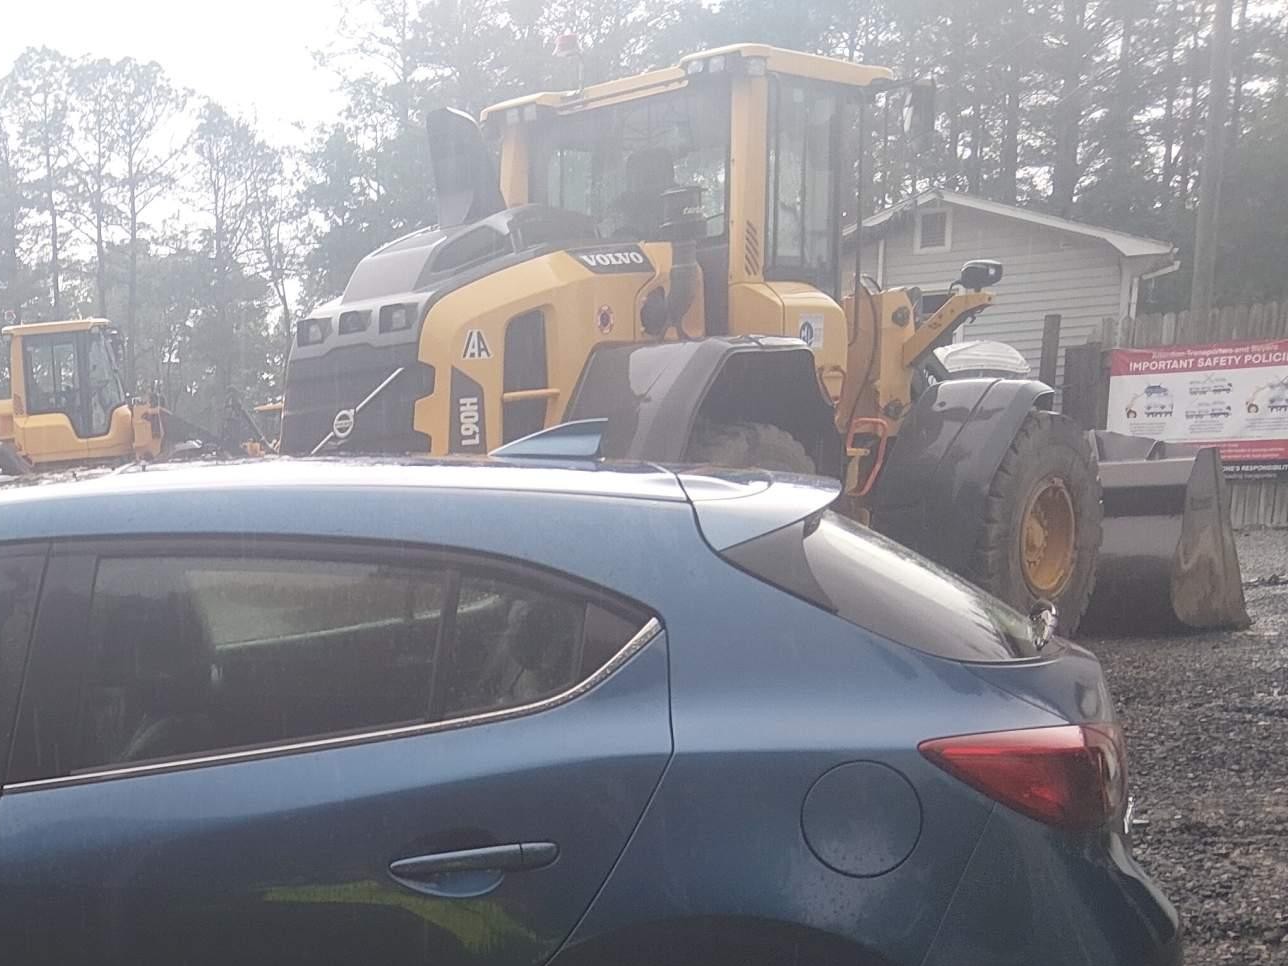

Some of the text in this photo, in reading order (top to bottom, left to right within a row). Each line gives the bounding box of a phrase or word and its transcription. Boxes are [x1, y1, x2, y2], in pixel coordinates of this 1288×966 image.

[579, 251, 644, 267] VOLVO
[1129, 352, 1288, 371] IMPORTANT SAFETY POLICI
[459, 397, 480, 446] L90H
